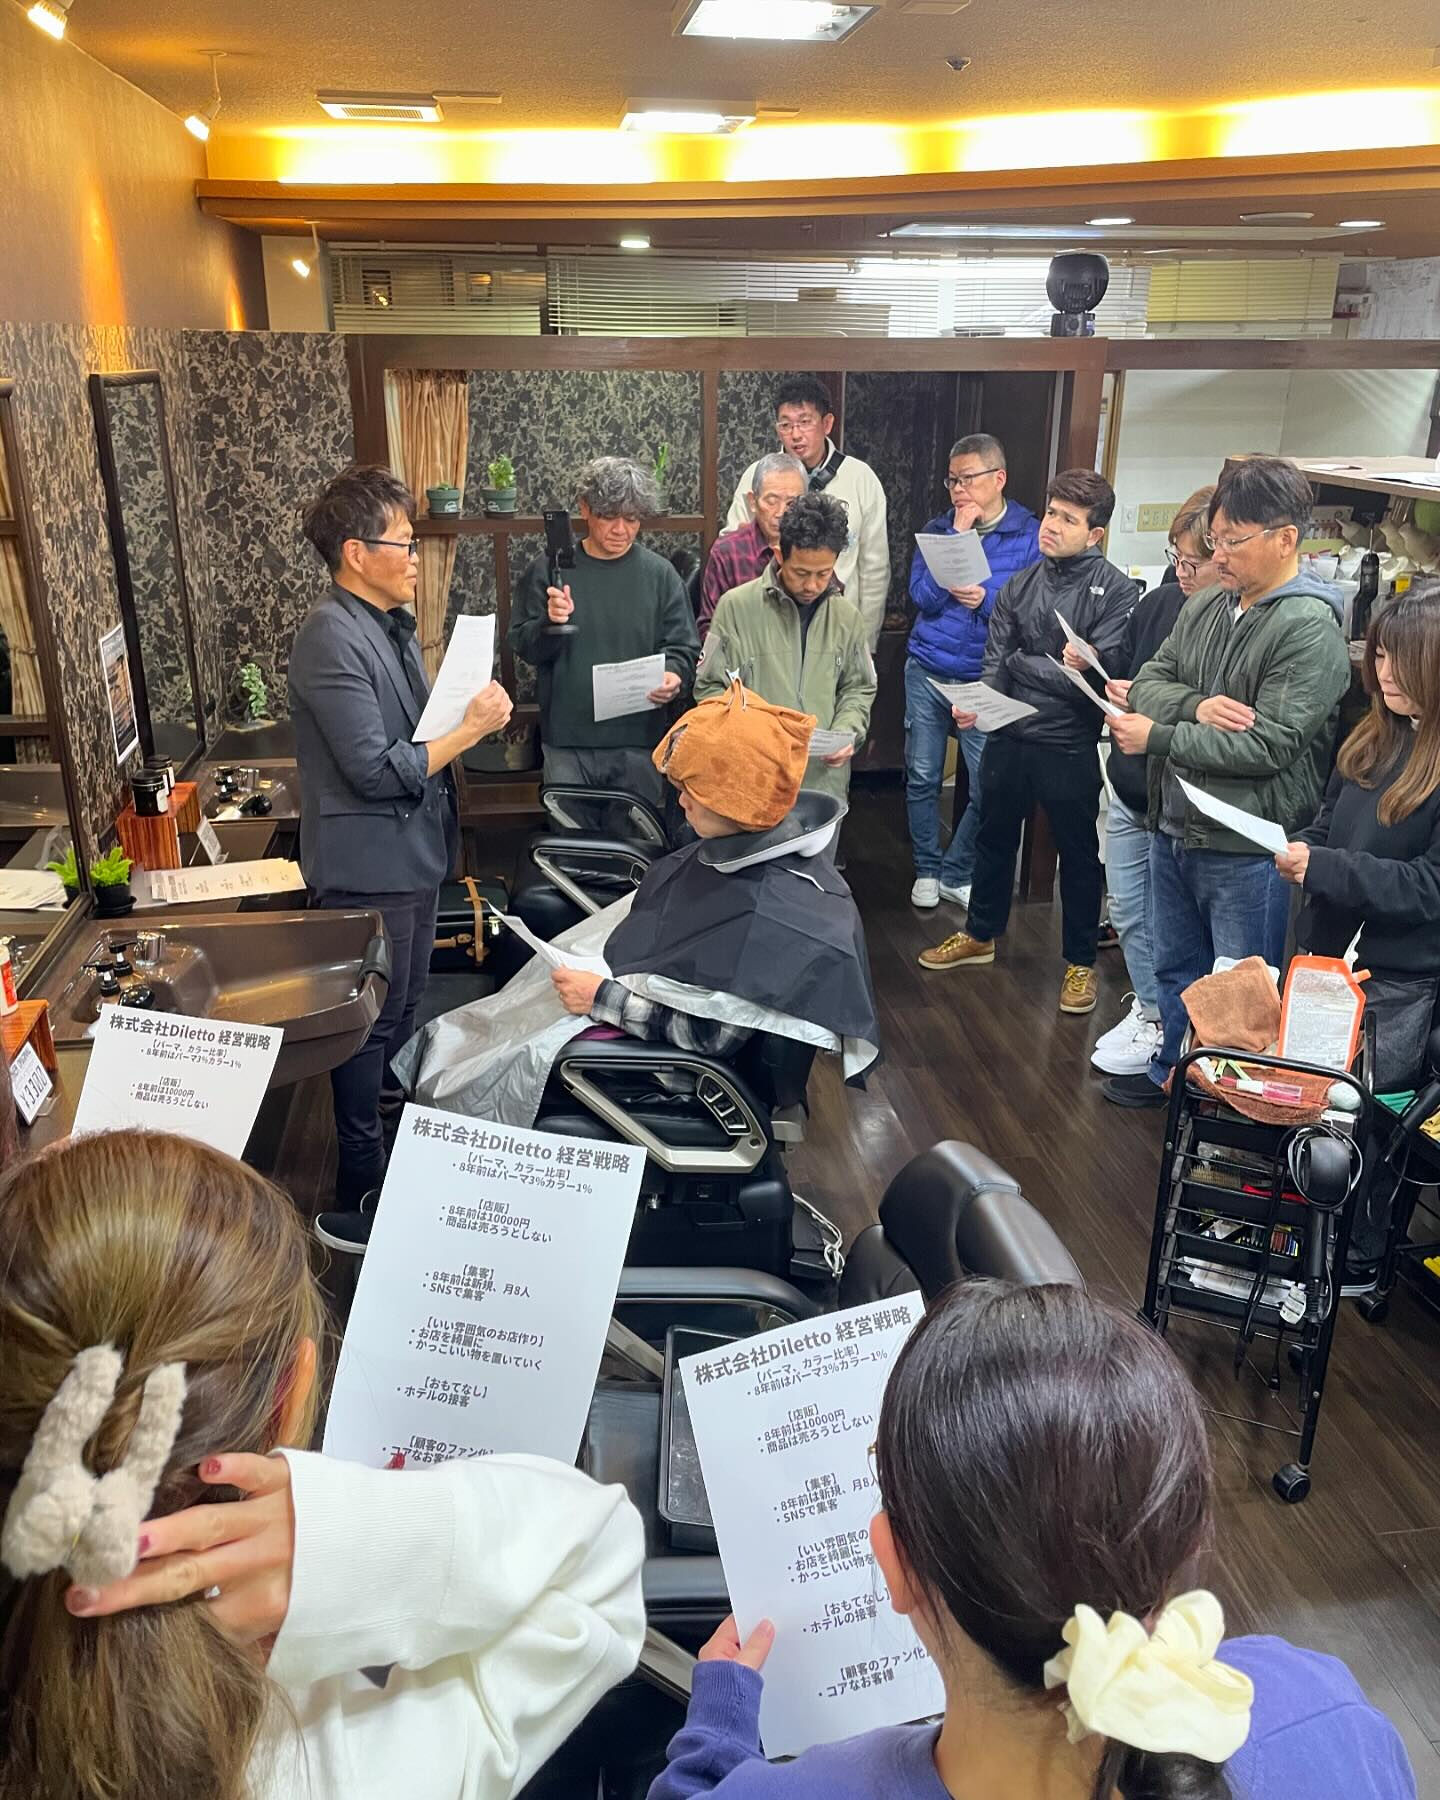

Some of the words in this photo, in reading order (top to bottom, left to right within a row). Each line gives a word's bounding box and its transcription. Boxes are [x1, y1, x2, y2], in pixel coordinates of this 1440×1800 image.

[109, 1013, 215, 1042] 株式会社Diletto
[218, 1029, 271, 1051] 経営戦略
[412, 1116, 551, 1160] 株式会社Diletto
[556, 1145, 630, 1174] 経営戦略
[694, 1331, 832, 1386] 株式会社Diletto
[835, 1306, 912, 1343] 経営戦略
